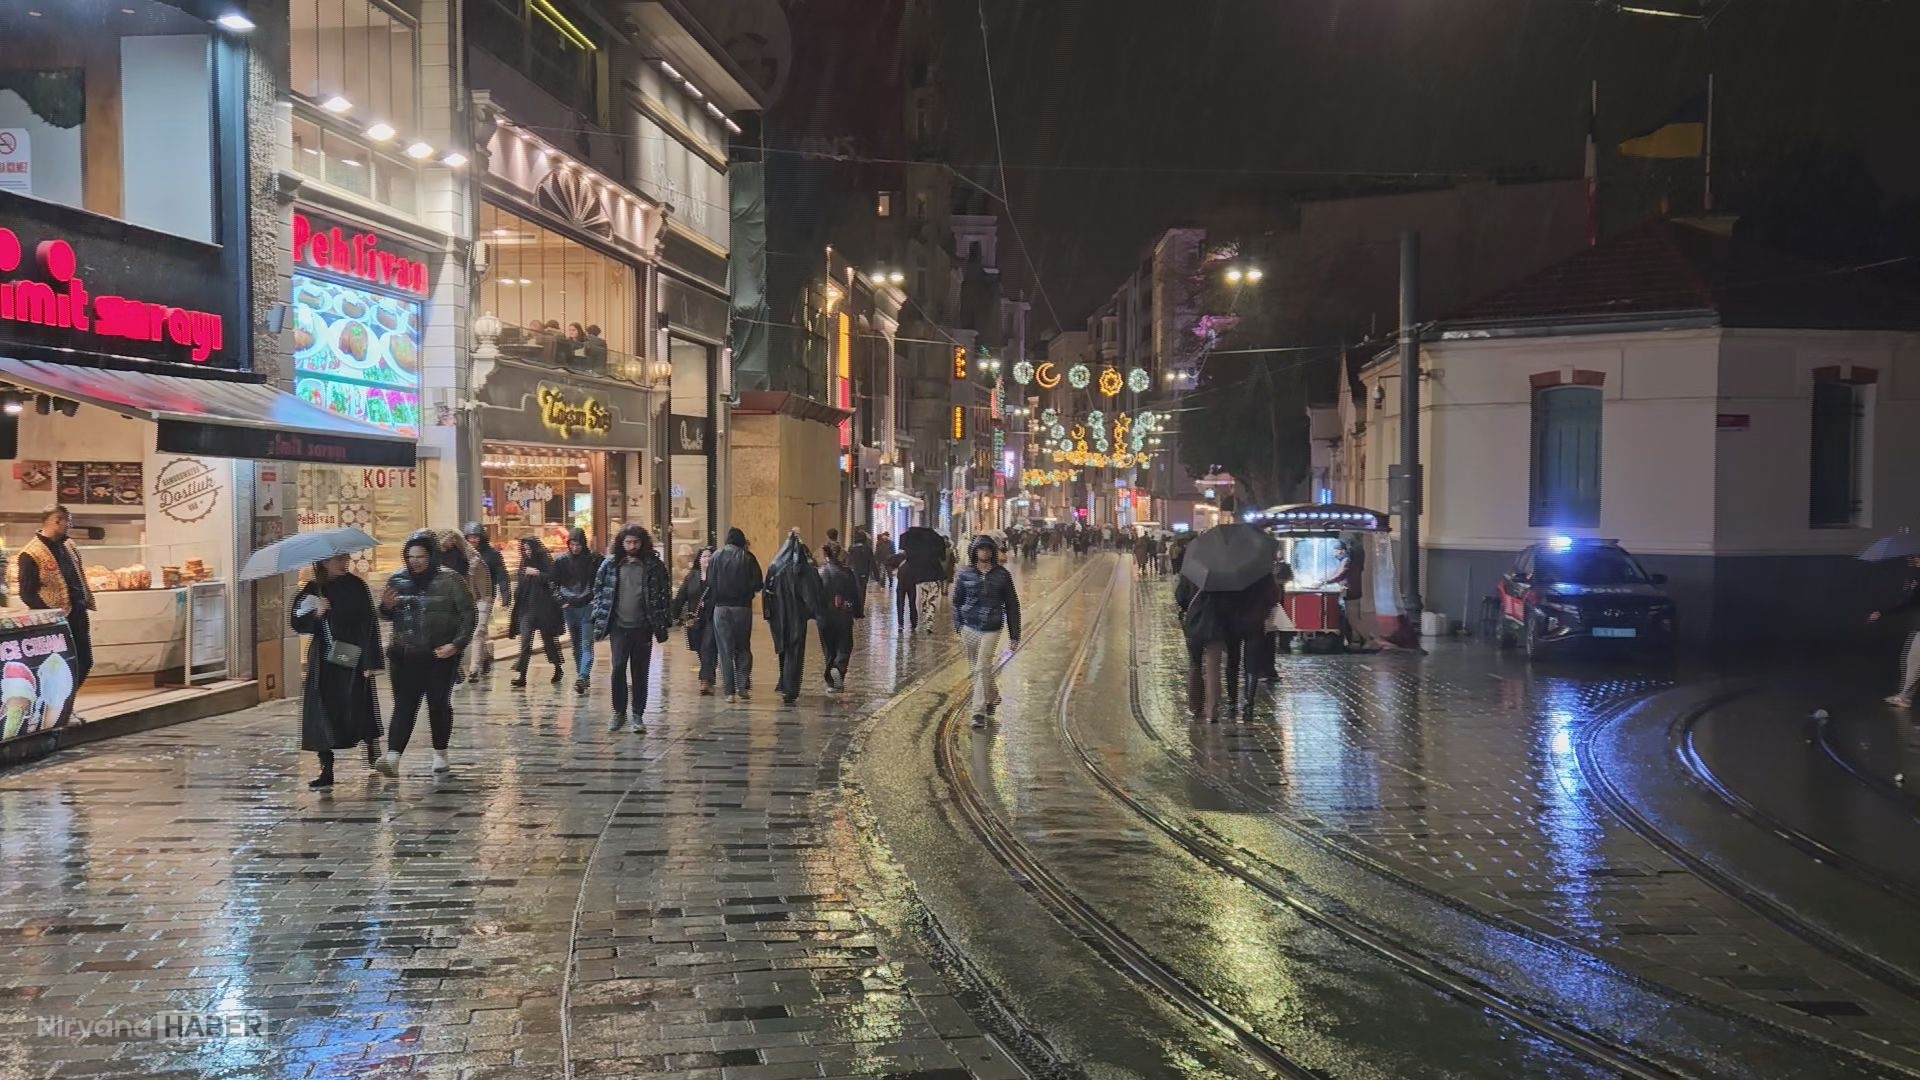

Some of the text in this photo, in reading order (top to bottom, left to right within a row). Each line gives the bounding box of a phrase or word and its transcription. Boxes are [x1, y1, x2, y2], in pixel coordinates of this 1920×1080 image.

[291, 212, 429, 297] Pehlivan
[0, 633, 68, 661] CE CREAM
